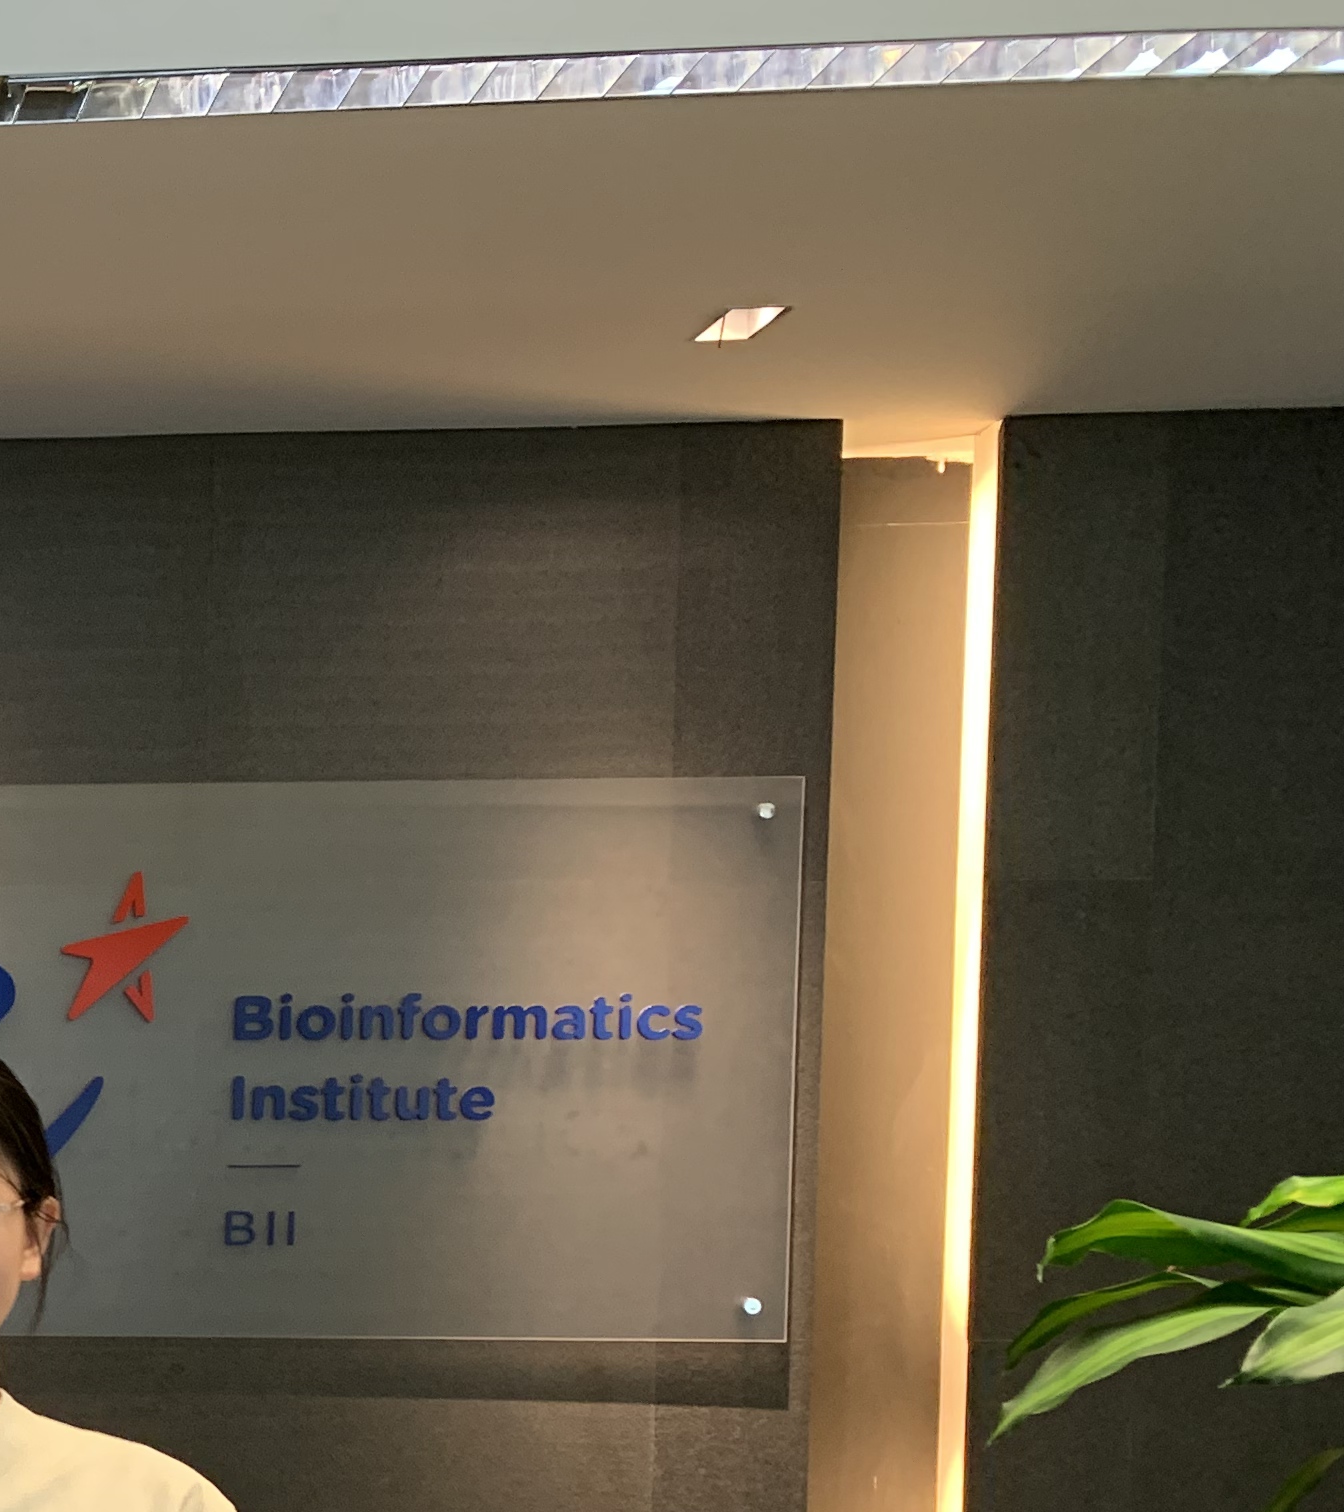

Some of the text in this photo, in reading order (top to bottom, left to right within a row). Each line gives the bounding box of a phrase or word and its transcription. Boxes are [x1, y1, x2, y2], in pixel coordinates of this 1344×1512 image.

[232, 992, 704, 1042] Bioinformatics
[230, 1073, 496, 1122] Institute
[223, 1210, 296, 1247] BII
